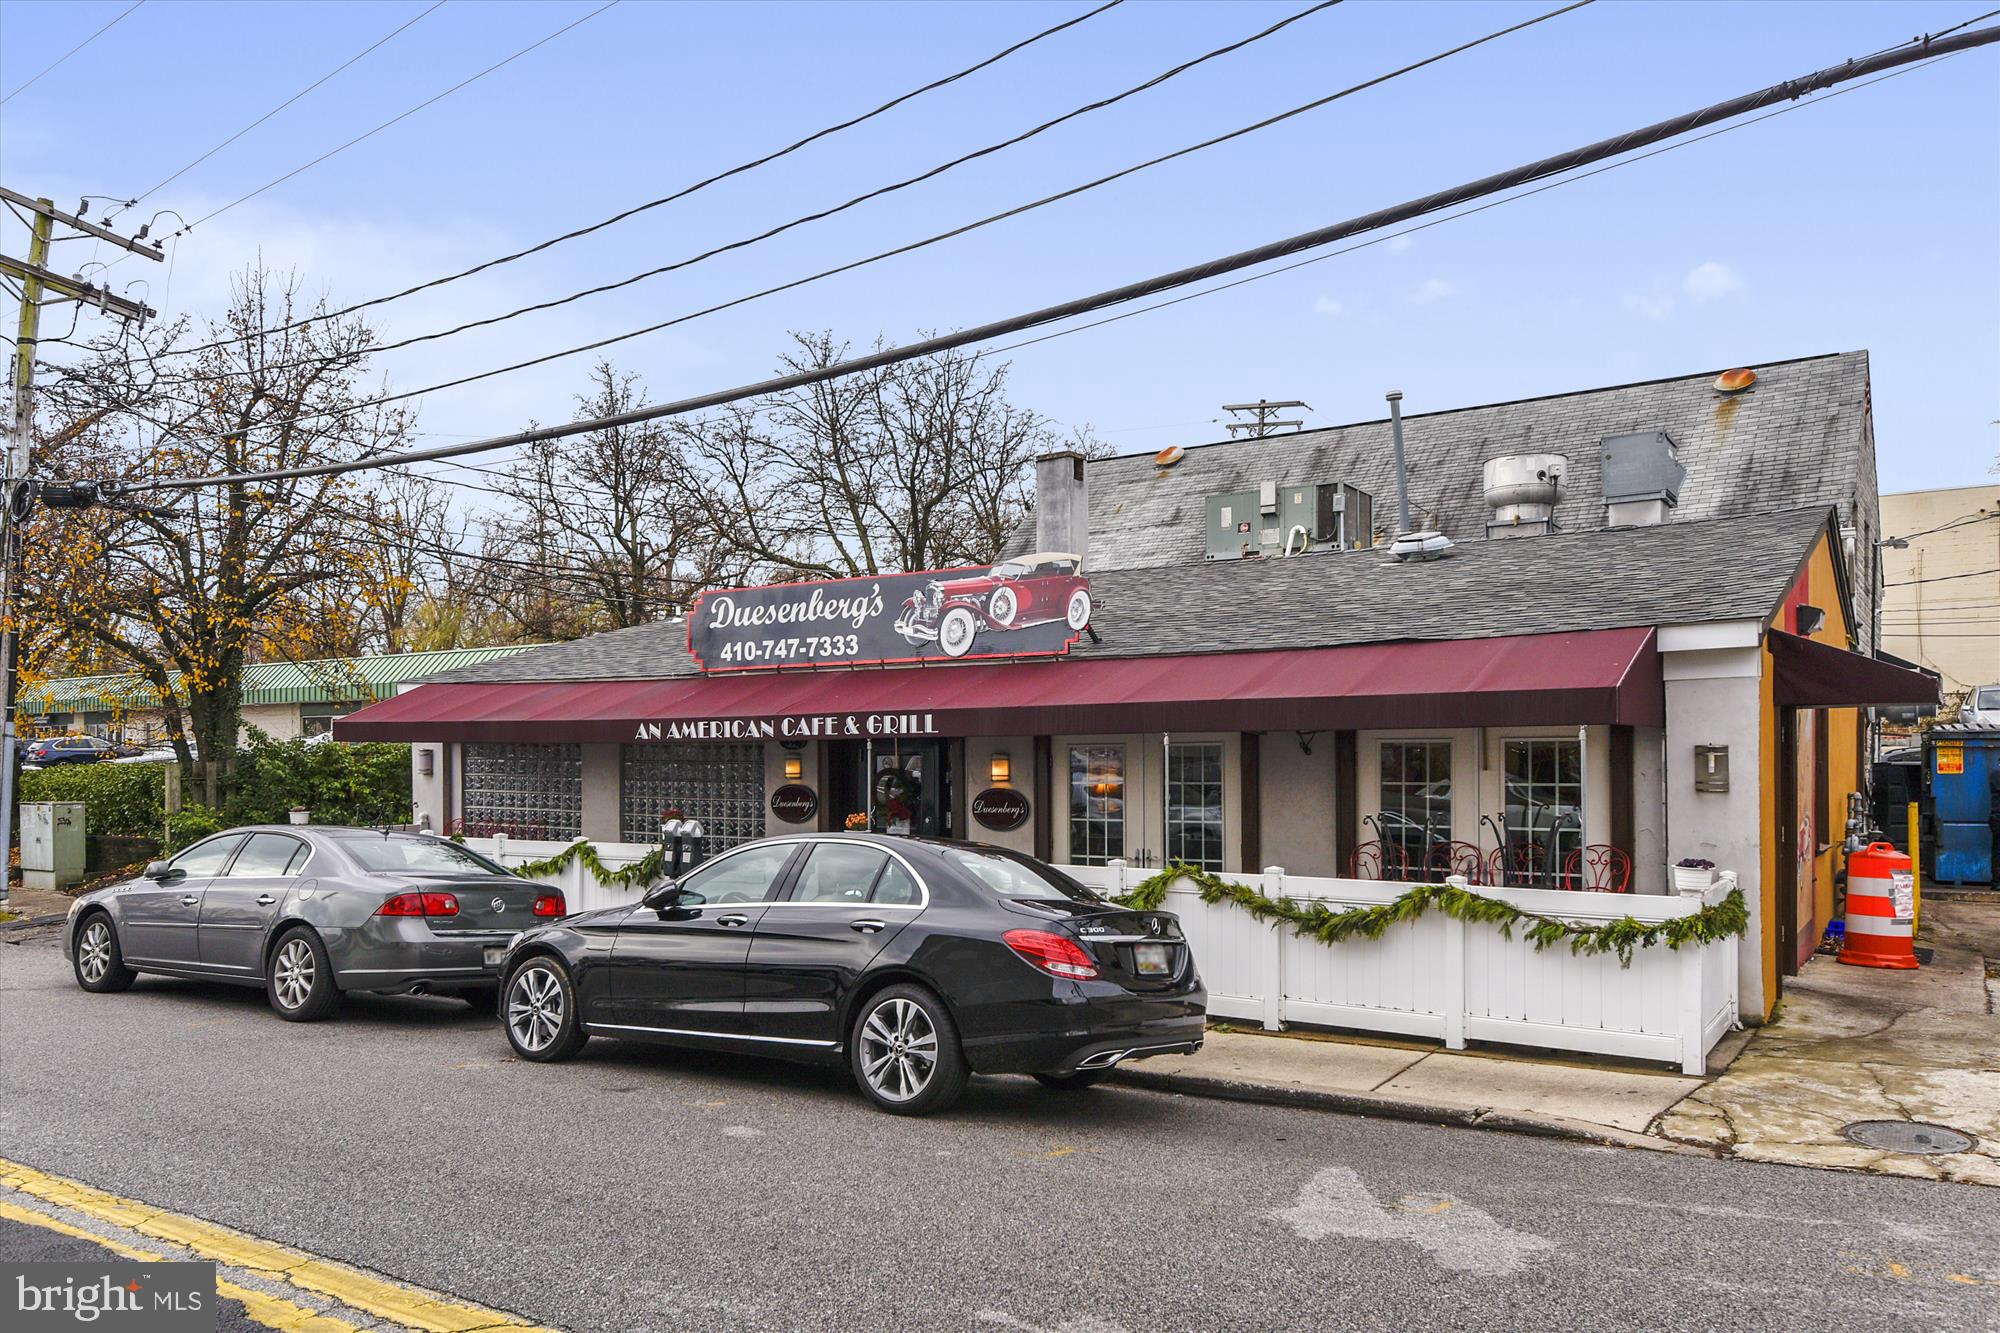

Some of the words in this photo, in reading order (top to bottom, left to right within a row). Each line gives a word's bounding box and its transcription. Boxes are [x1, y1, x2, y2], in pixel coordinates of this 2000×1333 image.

[709, 583, 884, 631] Duesenberg's
[720, 634, 860, 662] 410-747-7333
[635, 722, 662, 740] AN
[666, 719, 775, 739] AMERICAN
[780, 716, 838, 737] CAFE
[844, 715, 860, 735] &
[866, 713, 939, 735] GRILL
[772, 796, 814, 812] Duesenberg's
[973, 800, 1025, 819] Duesenberg's
